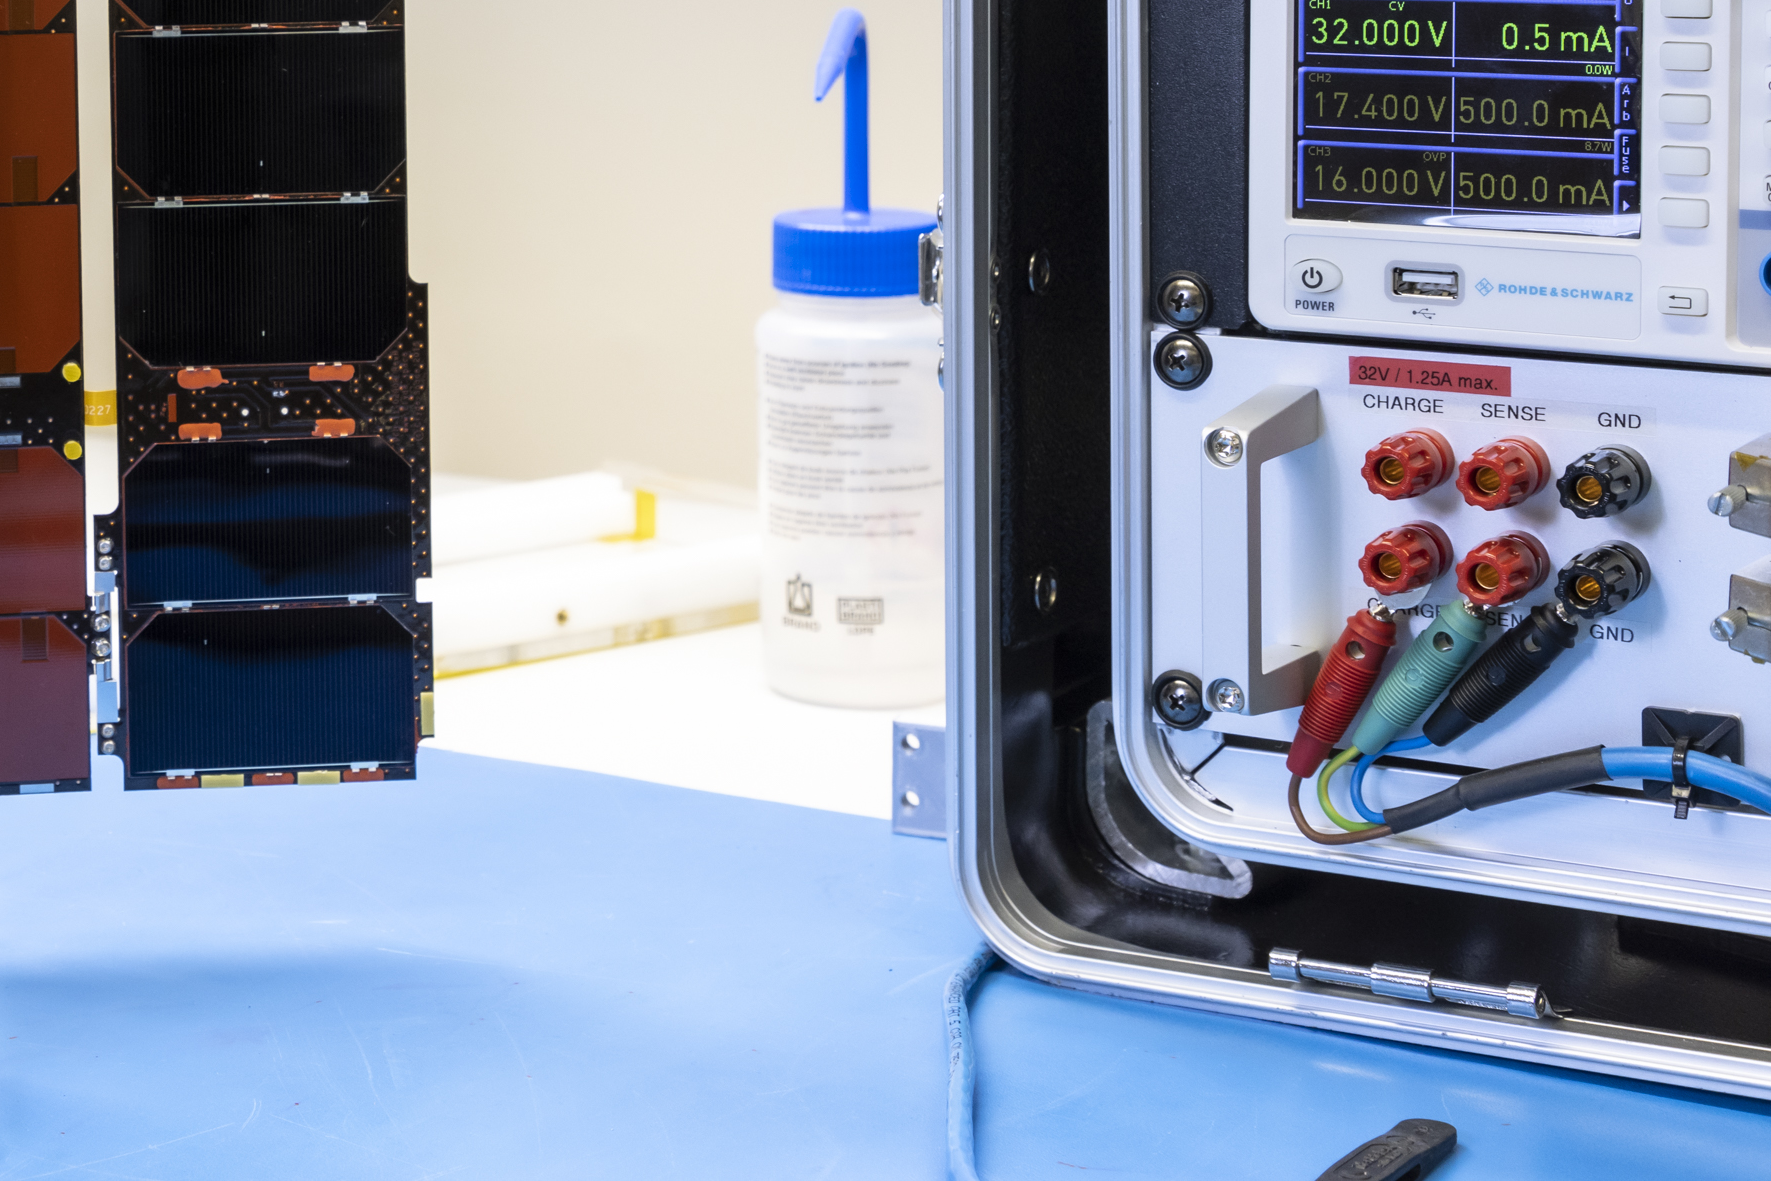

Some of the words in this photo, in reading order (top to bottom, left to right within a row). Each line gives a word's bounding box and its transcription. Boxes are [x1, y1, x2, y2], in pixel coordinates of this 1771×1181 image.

[1308, 0, 1331, 10] CH1
[1388, 1, 1405, 11] CV
[1311, 17, 1420, 47] 32.000
[1427, 20, 1448, 48] V
[1501, 22, 1550, 51] 0.5
[1560, 25, 1613, 53] mA
[1308, 72, 1332, 83] CH2
[1585, 64, 1613, 75] 0.0W
[1314, 91, 1420, 121] 17.400
[1427, 95, 1447, 123] V
[1459, 97, 1549, 127] 500.0
[1559, 102, 1612, 130] mA
[1621, 85, 1631, 121] Arb
[1308, 146, 1331, 157] CH3
[1423, 151, 1447, 162] OVP
[1585, 141, 1612, 152] 8.7W
[1621, 136, 1631, 174] Fuse
[1314, 165, 1419, 196] 16.000
[1426, 170, 1446, 197] V
[1458, 172, 1548, 203] 500.0
[1558, 179, 1611, 206] mA
[1295, 299, 1335, 312] POWER
[1357, 365, 1391, 383] 32V
[1394, 366, 1402, 384] /
[1406, 369, 1453, 388] 1.25A
[1458, 374, 1499, 391] max.
[1362, 393, 1445, 415] CHARGE
[1481, 402, 1546, 423] SENSE
[1597, 412, 1642, 430] GND
[1486, 611, 1523, 628] SEN
[1590, 624, 1635, 643] GND
